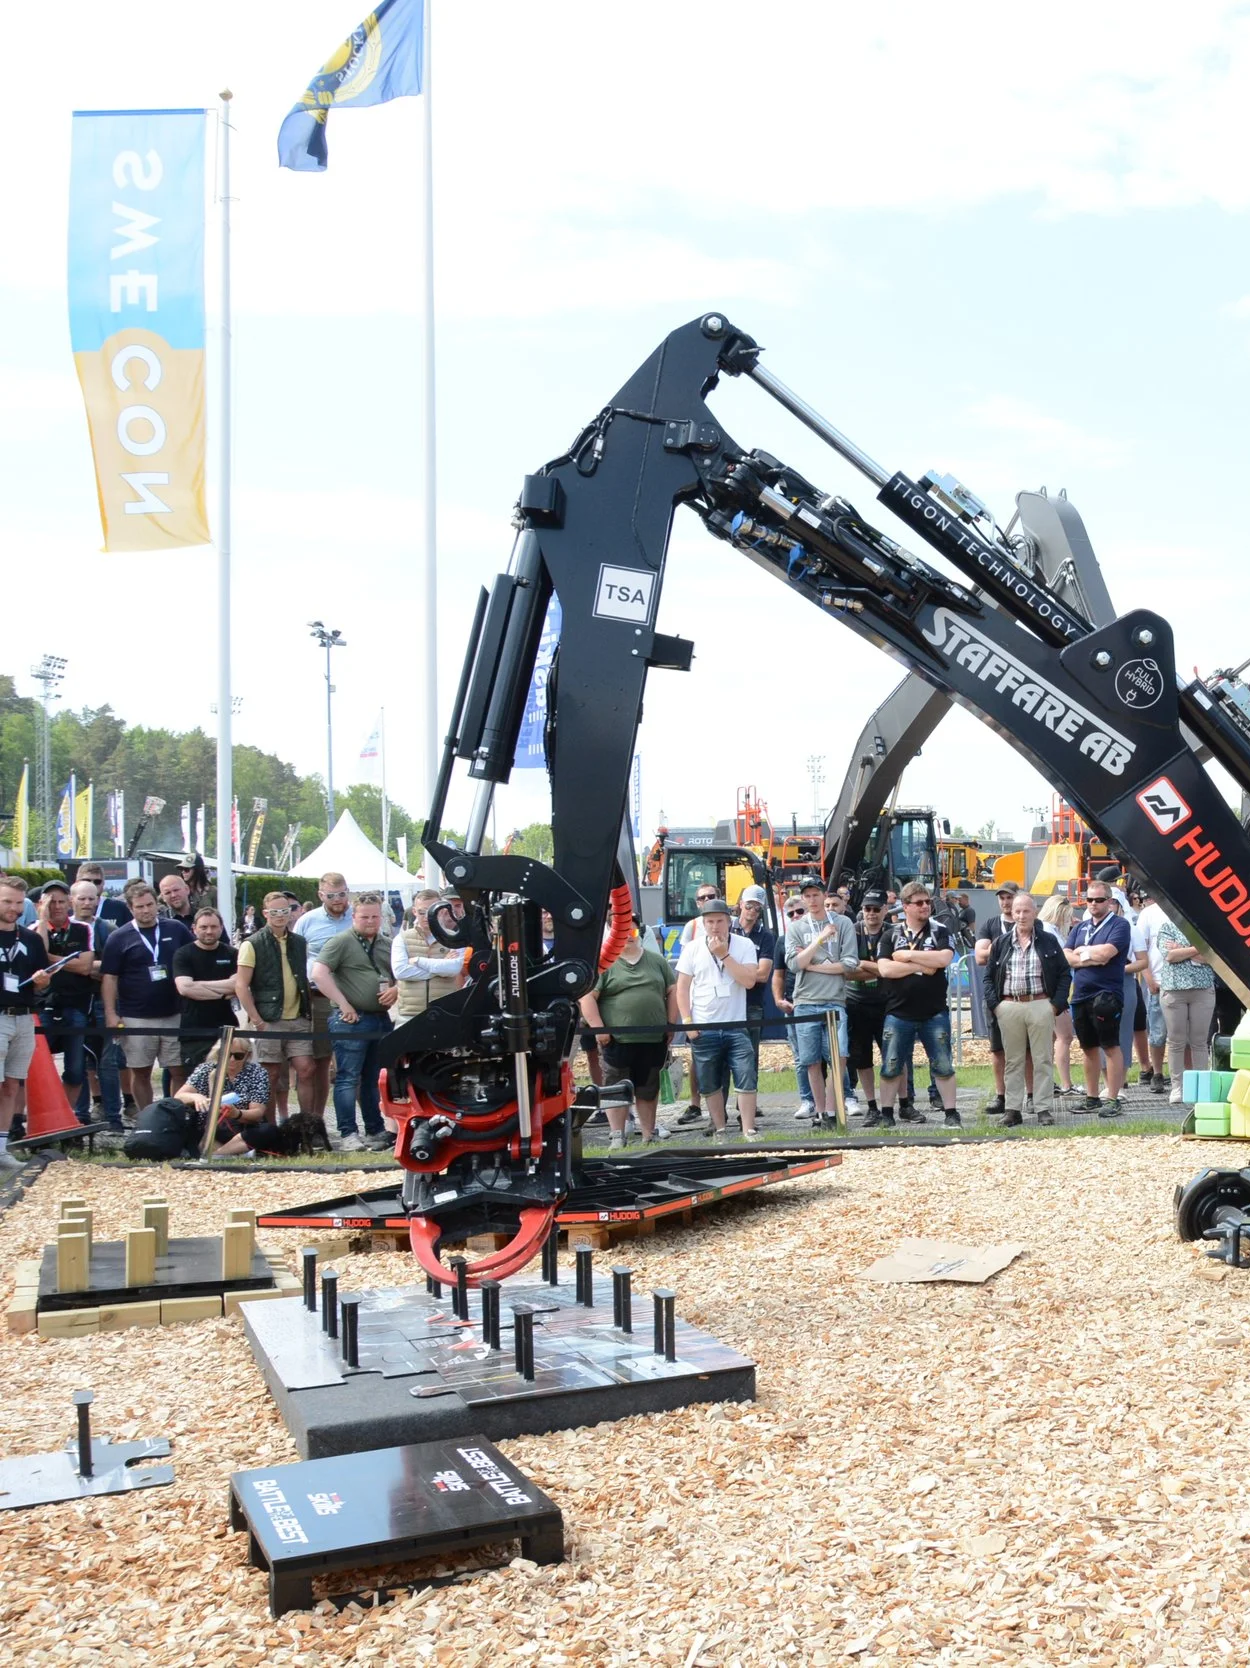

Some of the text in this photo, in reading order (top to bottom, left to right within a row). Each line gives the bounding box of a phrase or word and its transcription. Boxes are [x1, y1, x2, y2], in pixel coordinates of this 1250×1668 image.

[893, 477, 1077, 638] TIGON TECHNOLOGY
[605, 583, 645, 605] TSA
[1124, 670, 1155, 695] HYBRID
[1134, 666, 1154, 686] FULL
[922, 606, 1133, 776] STAFFARE AB
[510, 955, 520, 998] ROTOTILT
[342, 1218, 372, 1228] HUDDIG
[608, 1211, 641, 1221] HUDDIG
[456, 1447, 496, 1469] BEST
[252, 1479, 294, 1517] BATTLE
[480, 1471, 532, 1505] BATTLE
[271, 1517, 309, 1544] BEST
